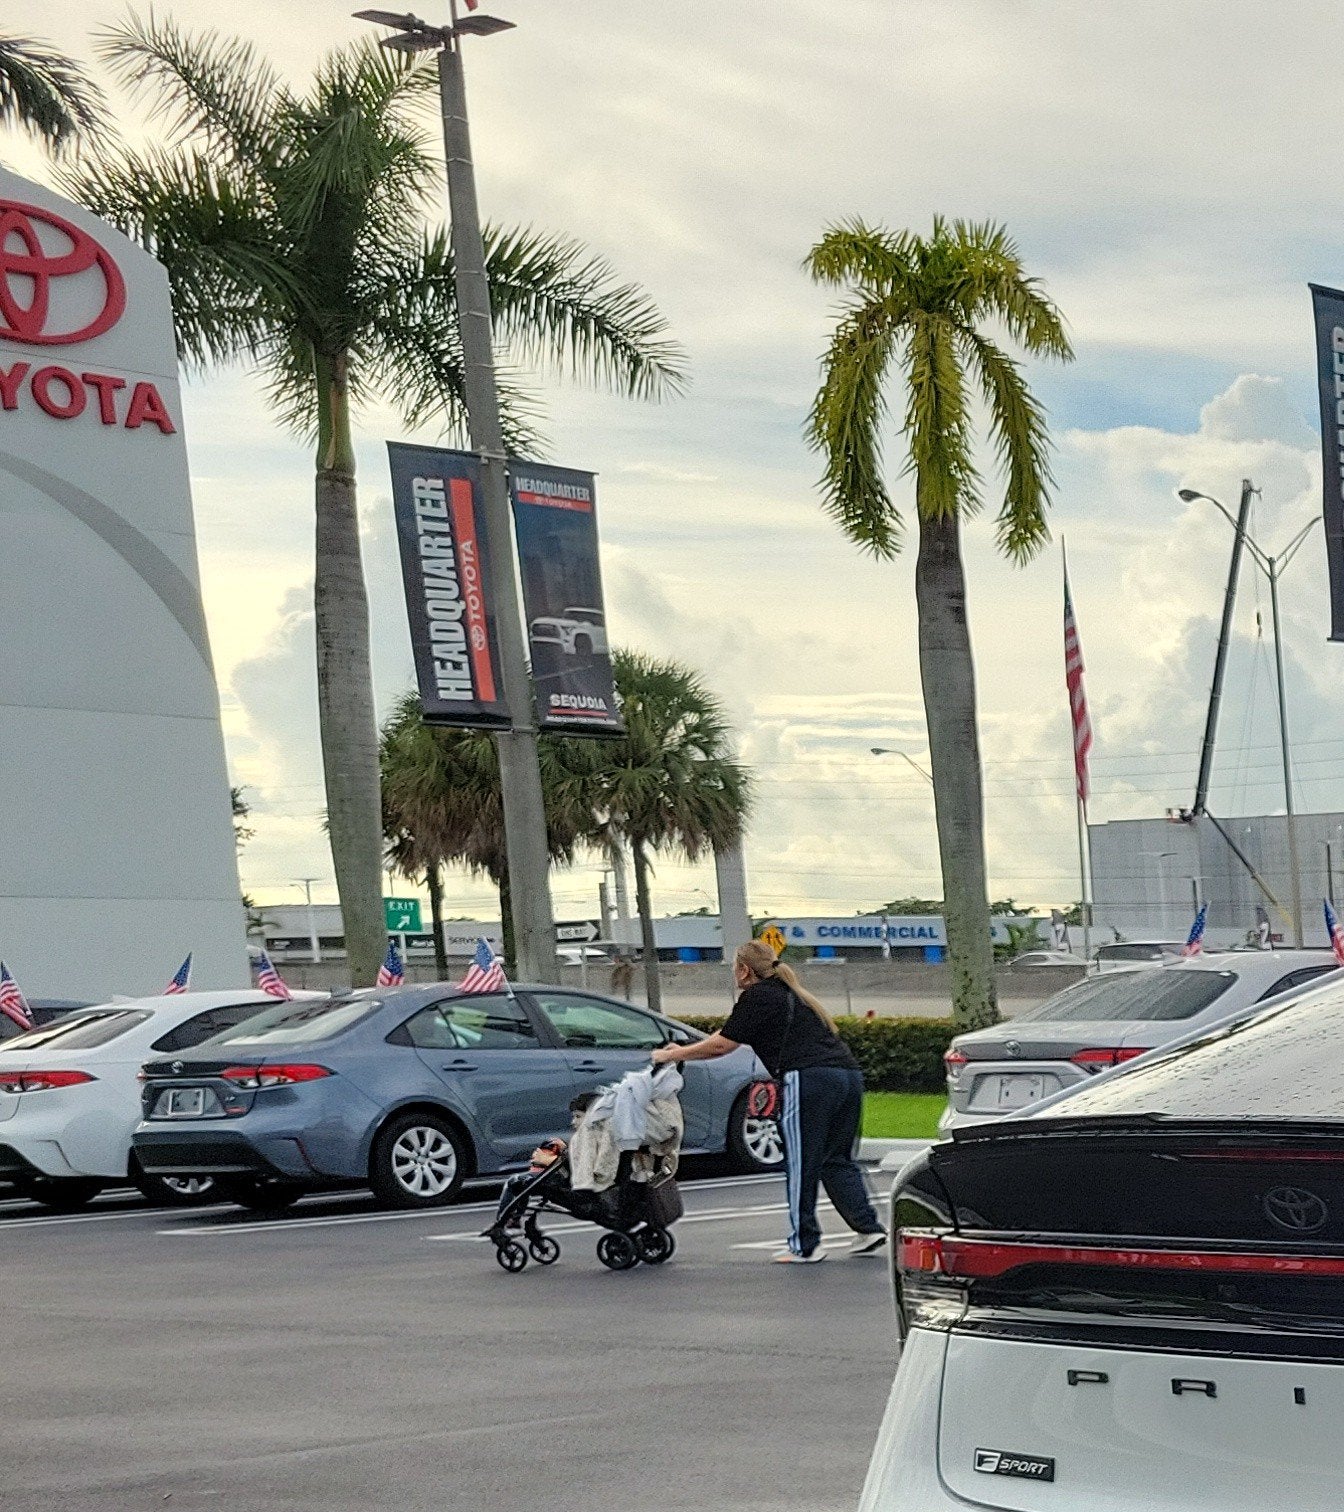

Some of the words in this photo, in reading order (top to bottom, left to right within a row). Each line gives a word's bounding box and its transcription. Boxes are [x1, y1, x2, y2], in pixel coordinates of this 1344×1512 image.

[516, 477, 590, 501] HEADQUARTER
[412, 476, 474, 701] HEADQUARTER
[461, 540, 482, 621] TOYOTA
[550, 694, 608, 710] SEQUOIA
[388, 901, 415, 911] EXIT
[818, 926, 938, 939] COMMERCIAL
[999, 1458, 1049, 1475] SPORT
